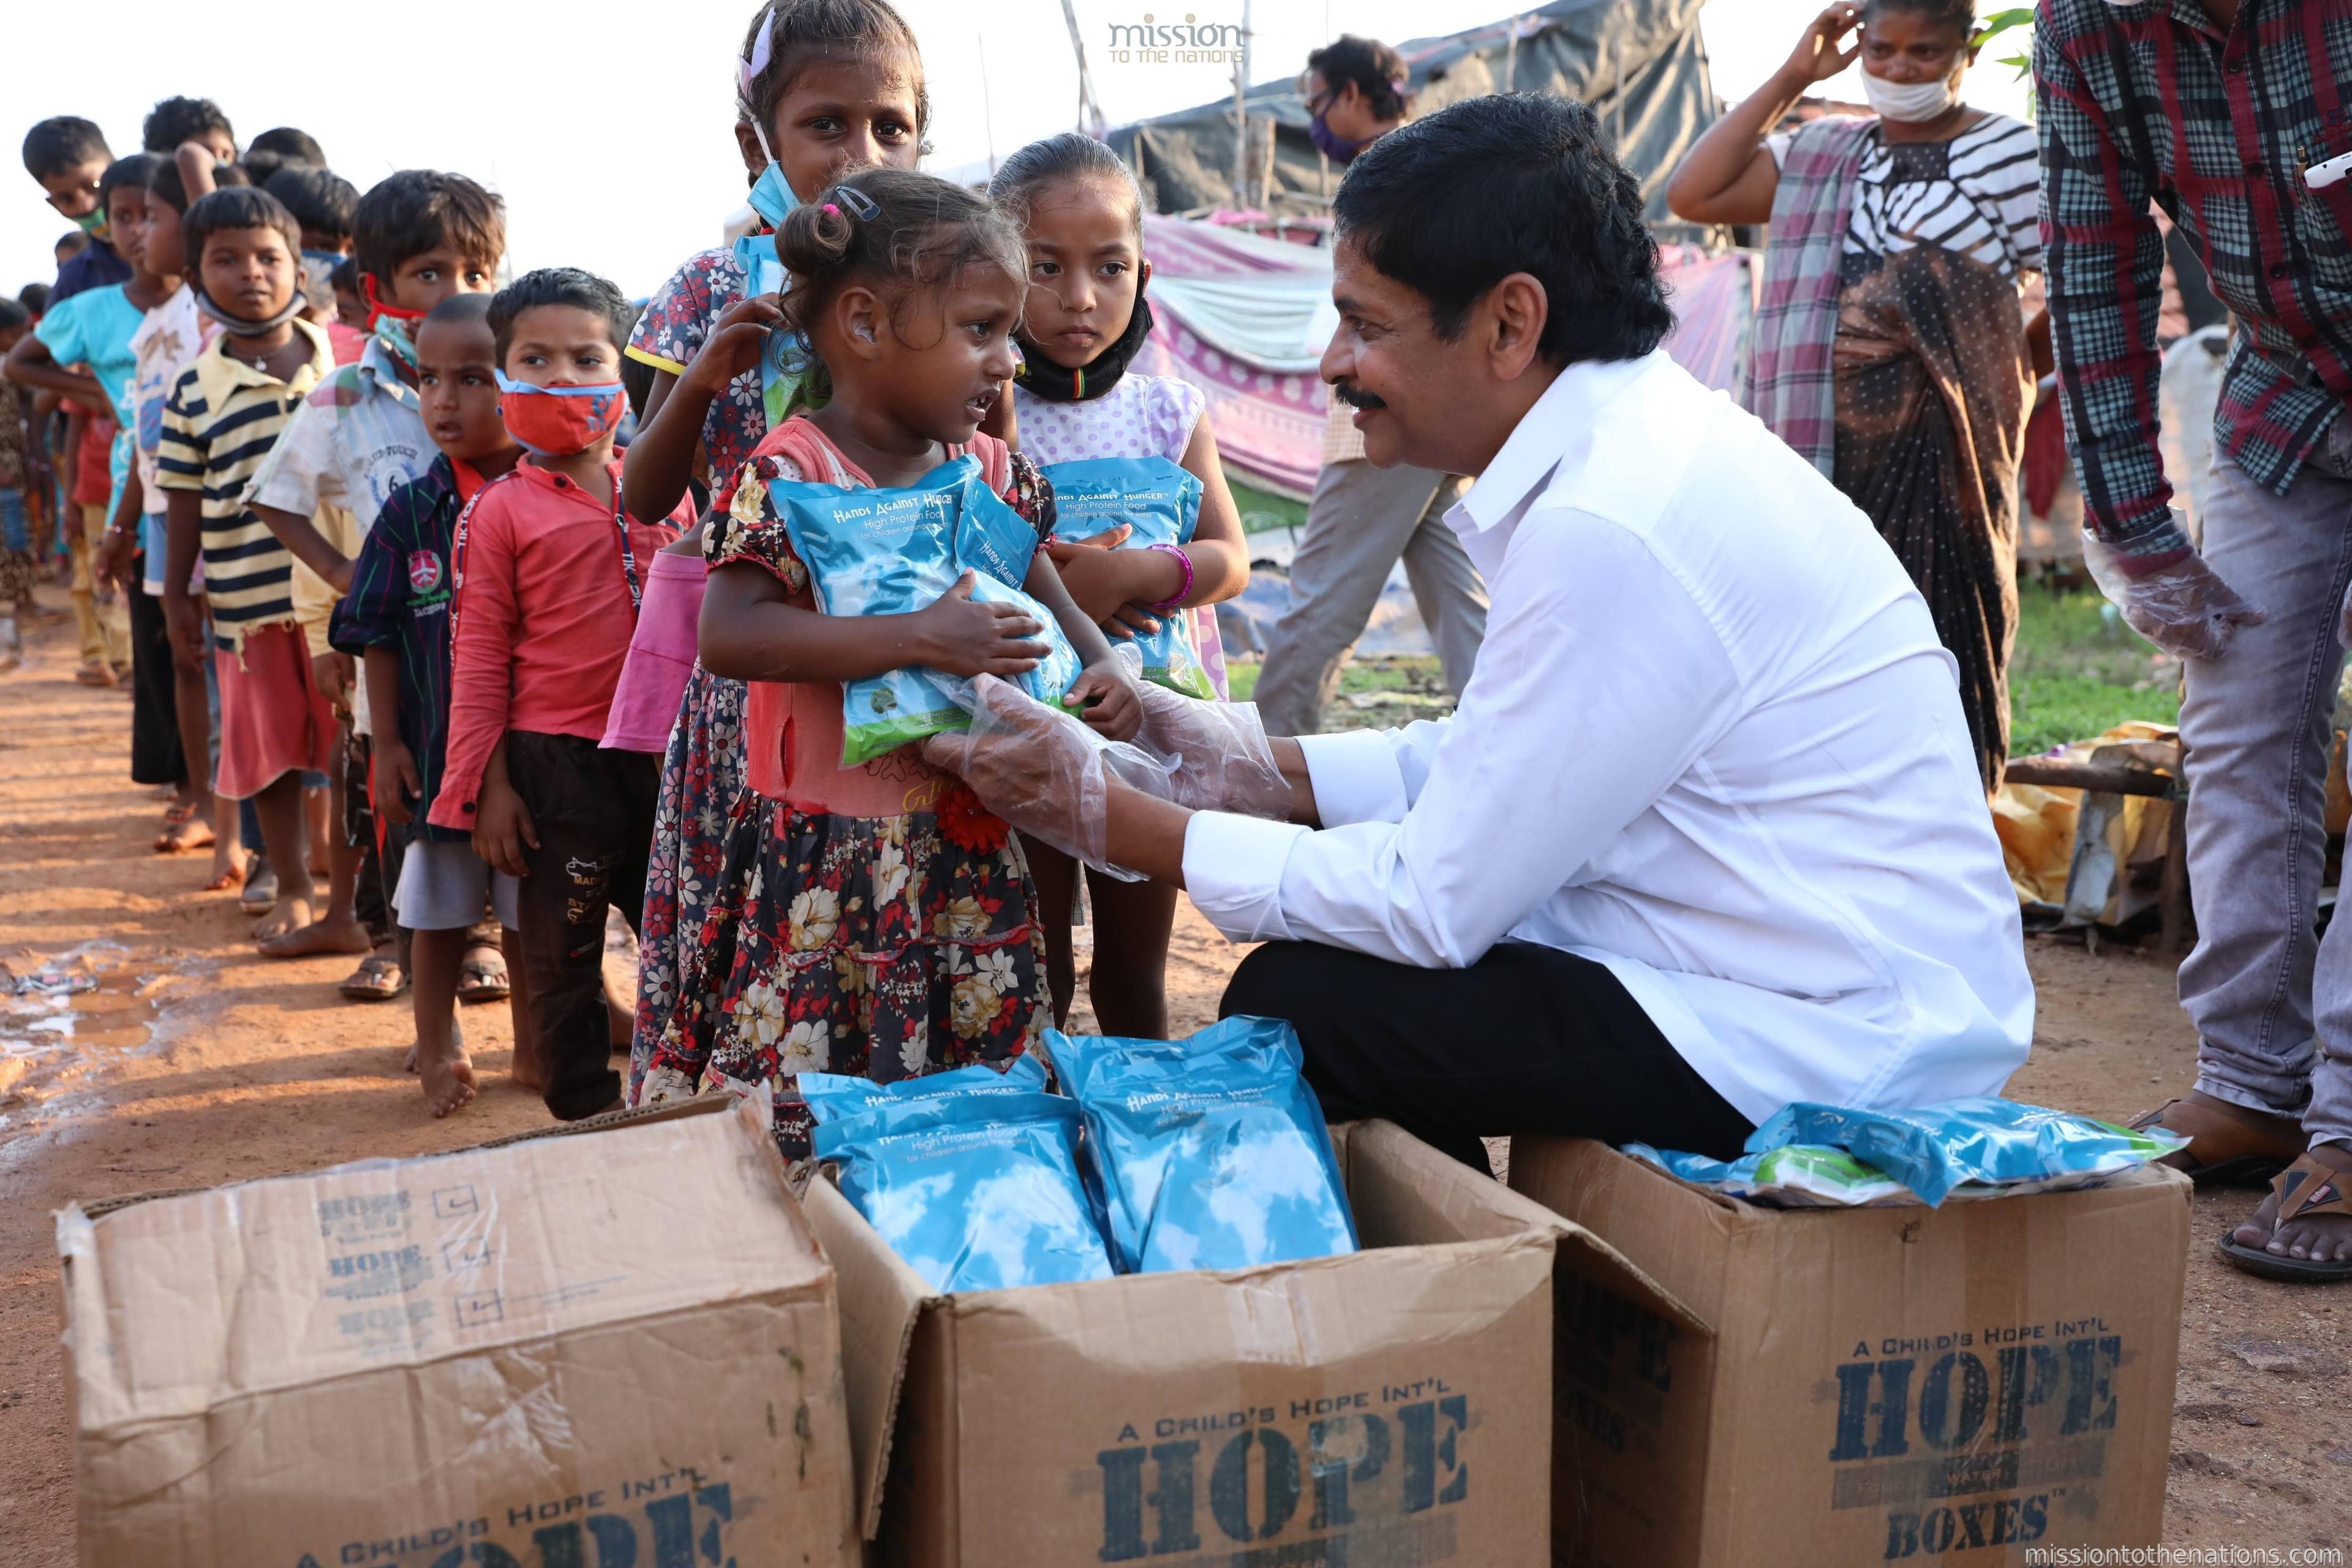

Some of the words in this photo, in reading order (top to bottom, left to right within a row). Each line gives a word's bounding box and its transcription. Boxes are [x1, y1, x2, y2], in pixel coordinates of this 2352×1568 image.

[1066, 502, 1087, 511] High
[1124, 502, 1147, 510] Food
[864, 518, 887, 530] High
[889, 513, 924, 526] Protein
[872, 527, 900, 538] children
[622, 551, 641, 606] TIKOK
[911, 1136, 941, 1152] High
[942, 1131, 985, 1145] Protein
[1853, 1341, 1870, 1357] A
[1828, 1335, 2121, 1462] HOPE
[1117, 1423, 1140, 1442] A
[1096, 1394, 1468, 1562] HOPE
